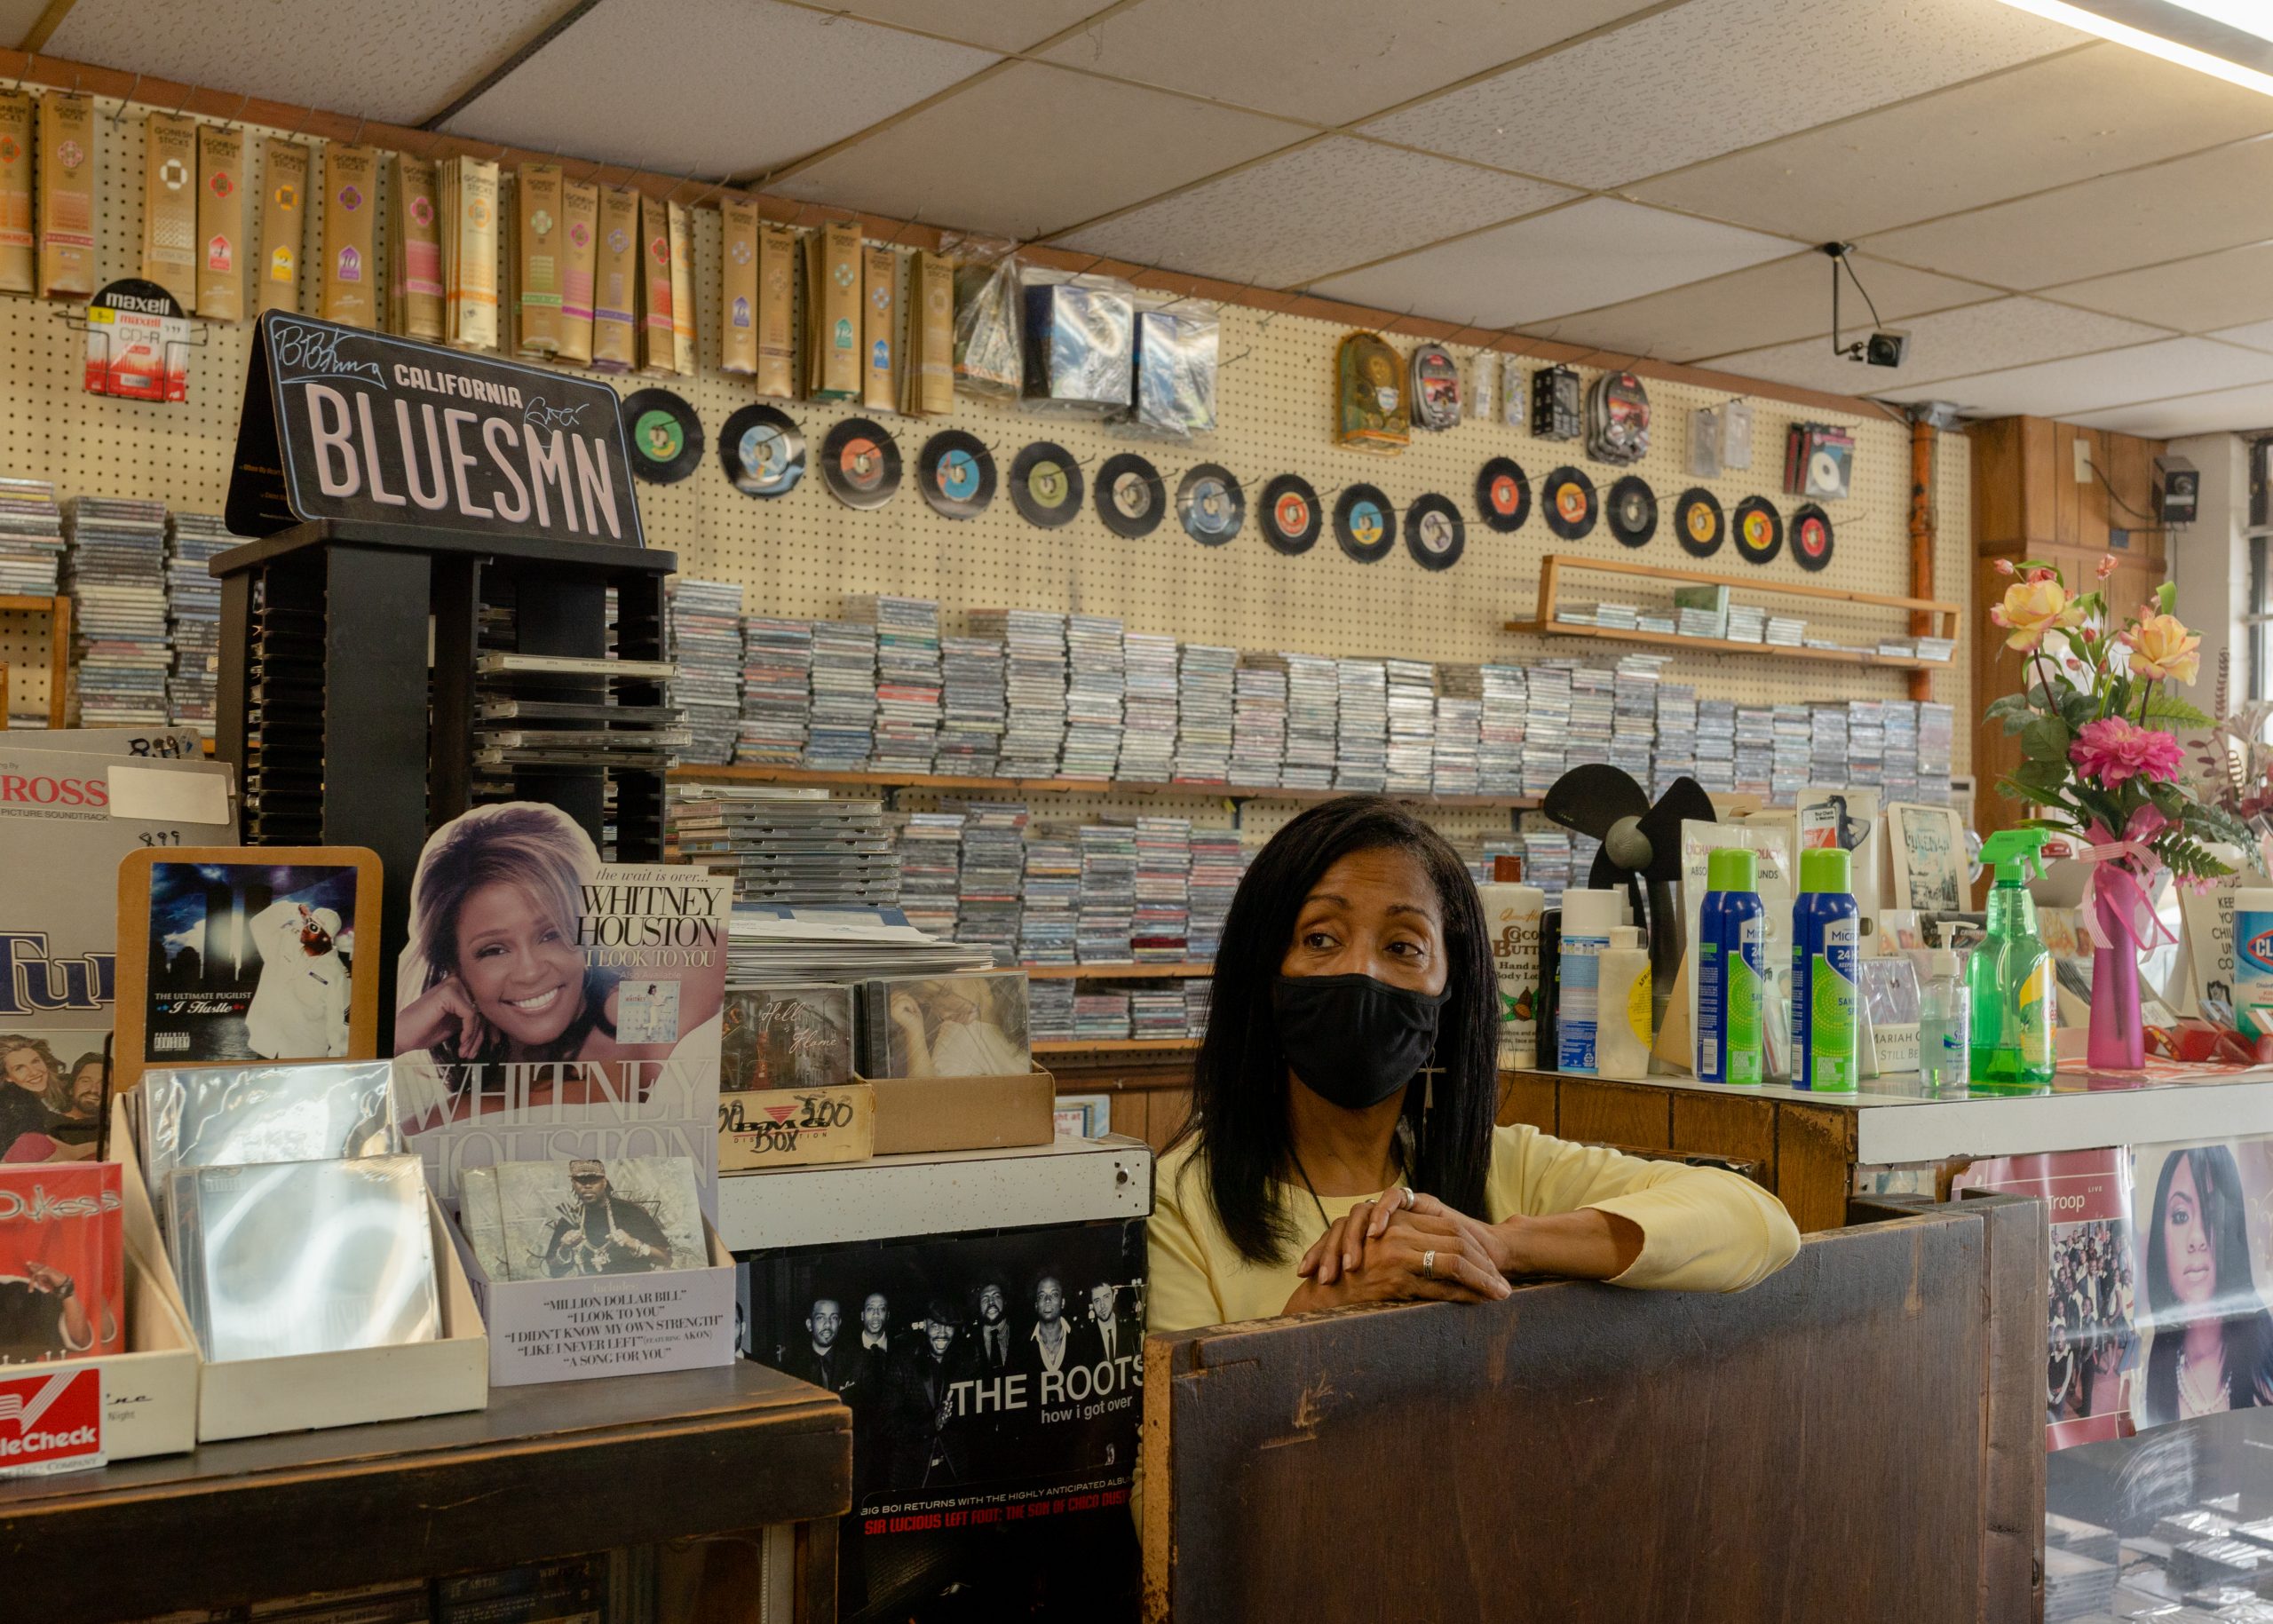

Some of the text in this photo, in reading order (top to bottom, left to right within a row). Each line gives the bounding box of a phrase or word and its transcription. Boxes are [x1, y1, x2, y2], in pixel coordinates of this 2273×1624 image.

[106, 291, 170, 315] maxell
[120, 314, 162, 328] maxell
[119, 327, 160, 345] CD-R
[393, 363, 524, 409] CALIFORNIA
[305, 383, 622, 540] BLUESMN
[1, 775, 108, 807] ROSS
[1, 809, 108, 821] PICTURE SOUNDTRACK
[596, 867, 709, 883] the wait is over...
[578, 884, 725, 916] WHITNEY
[2219, 912, 2233, 924] YO
[574, 915, 722, 947] HOUSTON
[587, 949, 717, 968] I LOOK TO YOU
[1837, 949, 1850, 960] 24
[1499, 962, 1530, 970] Hand
[186, 1001, 233, 1014] Hustle
[761, 1002, 806, 1032] Hell
[788, 1028, 838, 1054] Flame
[1869, 1032, 1913, 1044] MARIAH
[1881, 1050, 1905, 1060] STILL
[397, 1059, 715, 1133] WHITNEY
[734, 1131, 827, 1145] DISTION
[750, 1129, 799, 1153] BOX
[2047, 1193, 2086, 1213] Troop
[604, 1293, 653, 1307] DOLLAR
[580, 1310, 613, 1323] LOOK
[616, 1309, 634, 1319] TO
[564, 1325, 600, 1340] KNOW
[605, 1323, 622, 1335] MY
[625, 1320, 653, 1334] OWN
[556, 1343, 562, 1354] I
[564, 1338, 606, 1353] NEVER
[580, 1351, 613, 1366] SONG
[615, 1350, 640, 1362] FOR
[949, 1374, 1028, 1416] THE
[1041, 1396, 1133, 1424] how i got over
[860, 1506, 880, 1516] BIG
[882, 1504, 902, 1514] BOI
[904, 1499, 956, 1512] RETURNS
[957, 1496, 984, 1507] WITH
[986, 1493, 1007, 1503] THE
[1009, 1489, 1045, 1501] HIGHLY
[1046, 1480, 1106, 1495] ANTICIPATED
[864, 1518, 887, 1535] SIR
[890, 1513, 942, 1533] LUCIOUS
[945, 1511, 968, 1527] LEFT
[1006, 1504, 1025, 1520] THE
[1027, 1501, 1050, 1517] SON
[1053, 1499, 1066, 1514] OF
[1068, 1493, 1100, 1511] CHICO
